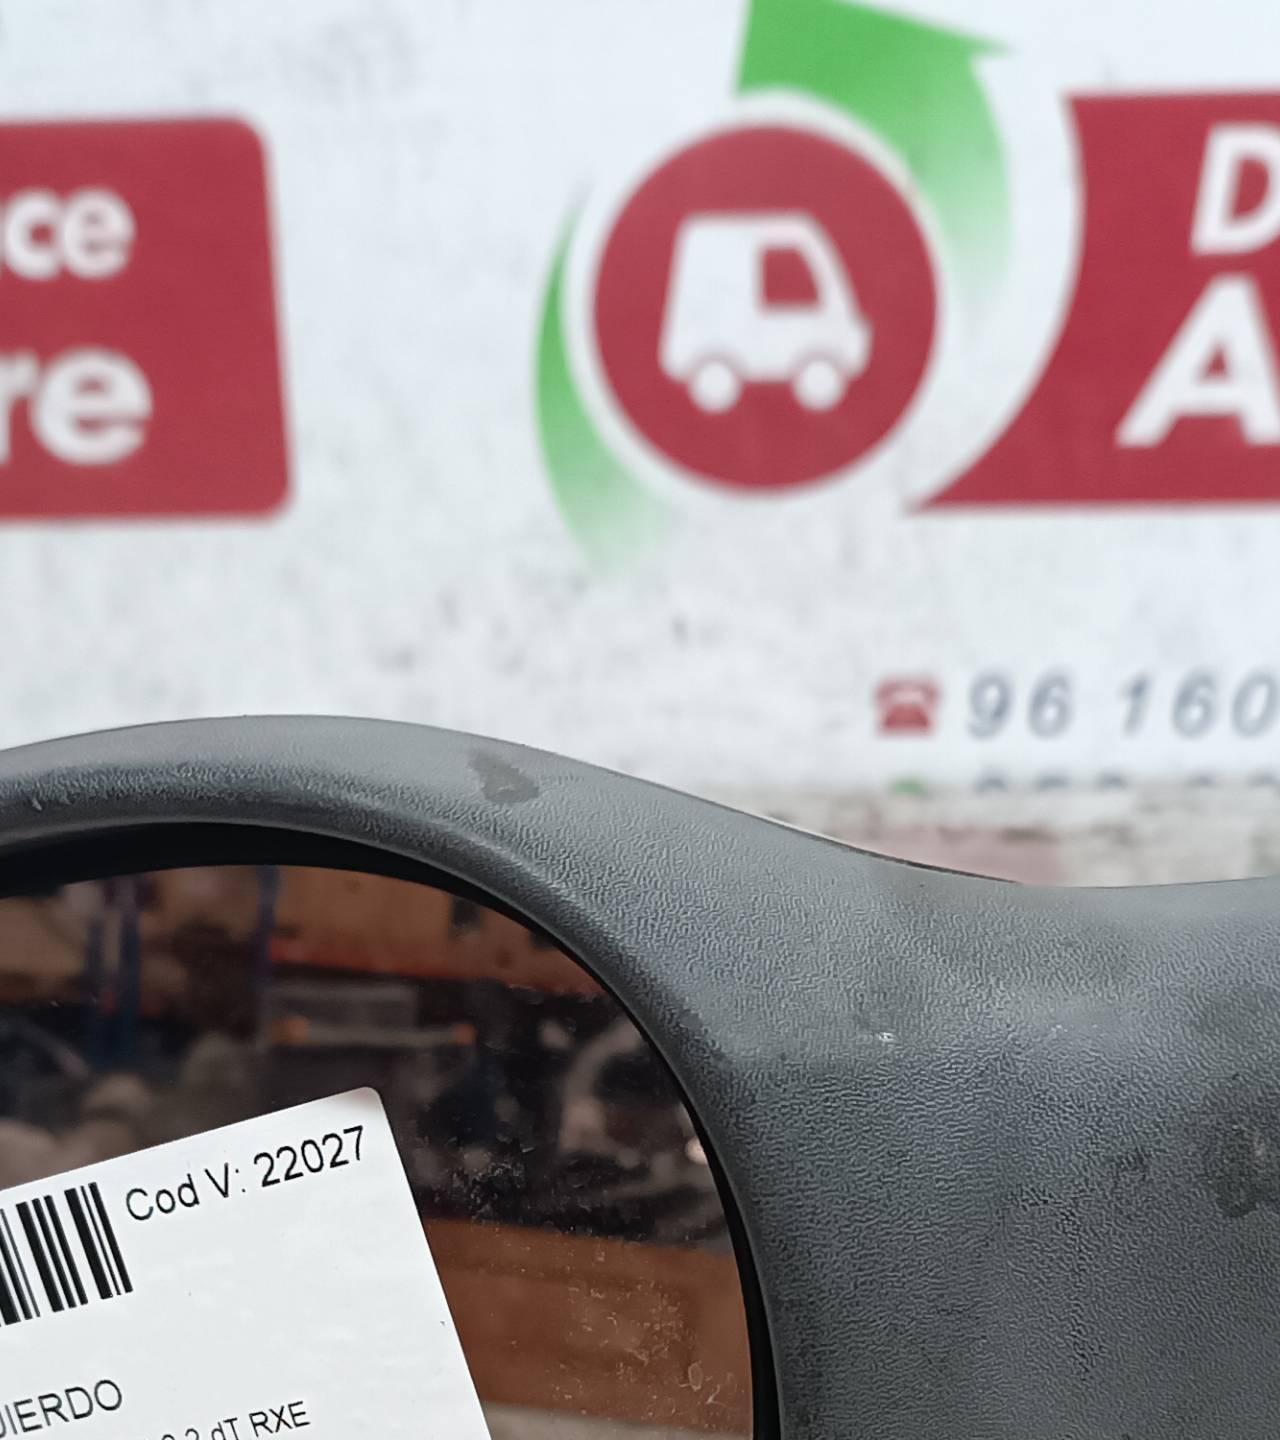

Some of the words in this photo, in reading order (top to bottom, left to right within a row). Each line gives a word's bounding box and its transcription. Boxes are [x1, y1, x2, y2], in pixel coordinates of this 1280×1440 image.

[966, 670, 1076, 740] 96
[124, 1172, 201, 1222] Cod
[204, 1161, 247, 1199] V:
[252, 1125, 365, 1189] 22027
[247, 1400, 313, 1439] RXE
